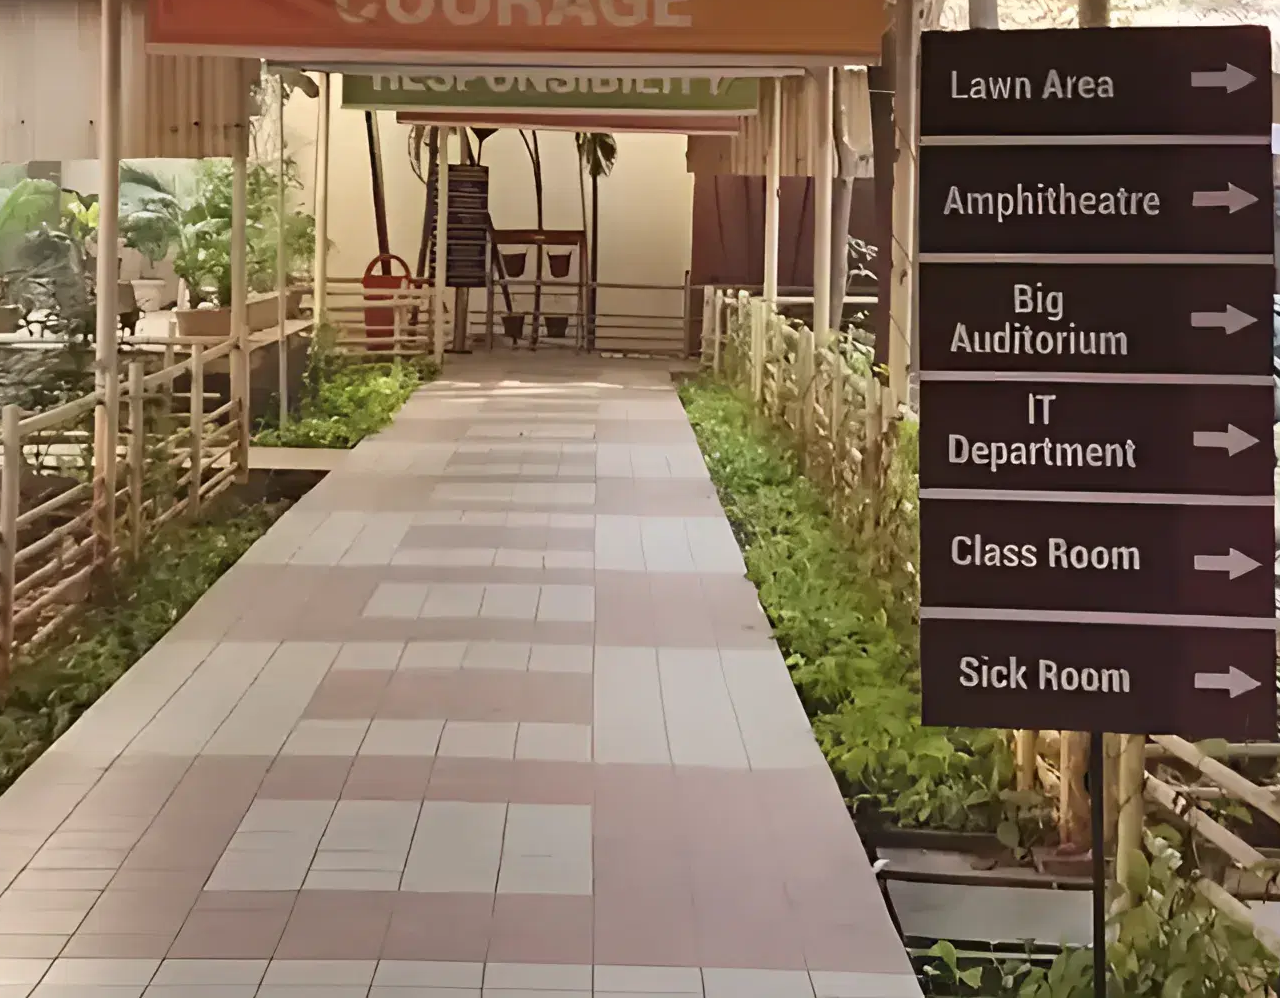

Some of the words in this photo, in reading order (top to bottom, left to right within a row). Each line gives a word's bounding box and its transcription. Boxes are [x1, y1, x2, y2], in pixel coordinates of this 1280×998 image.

[951, 70, 1031, 100] Lawn
[1041, 68, 1114, 100] Area
[943, 182, 1161, 223] Amphitheatre
[1013, 281, 1064, 321] Big
[950, 321, 1128, 355] Auditorium
[1028, 392, 1057, 425] IT
[948, 433, 1137, 473] Department
[951, 533, 1038, 568] Class
[1048, 537, 1141, 570] Room
[959, 655, 1028, 690] Sick
[1038, 658, 1130, 693] Room
